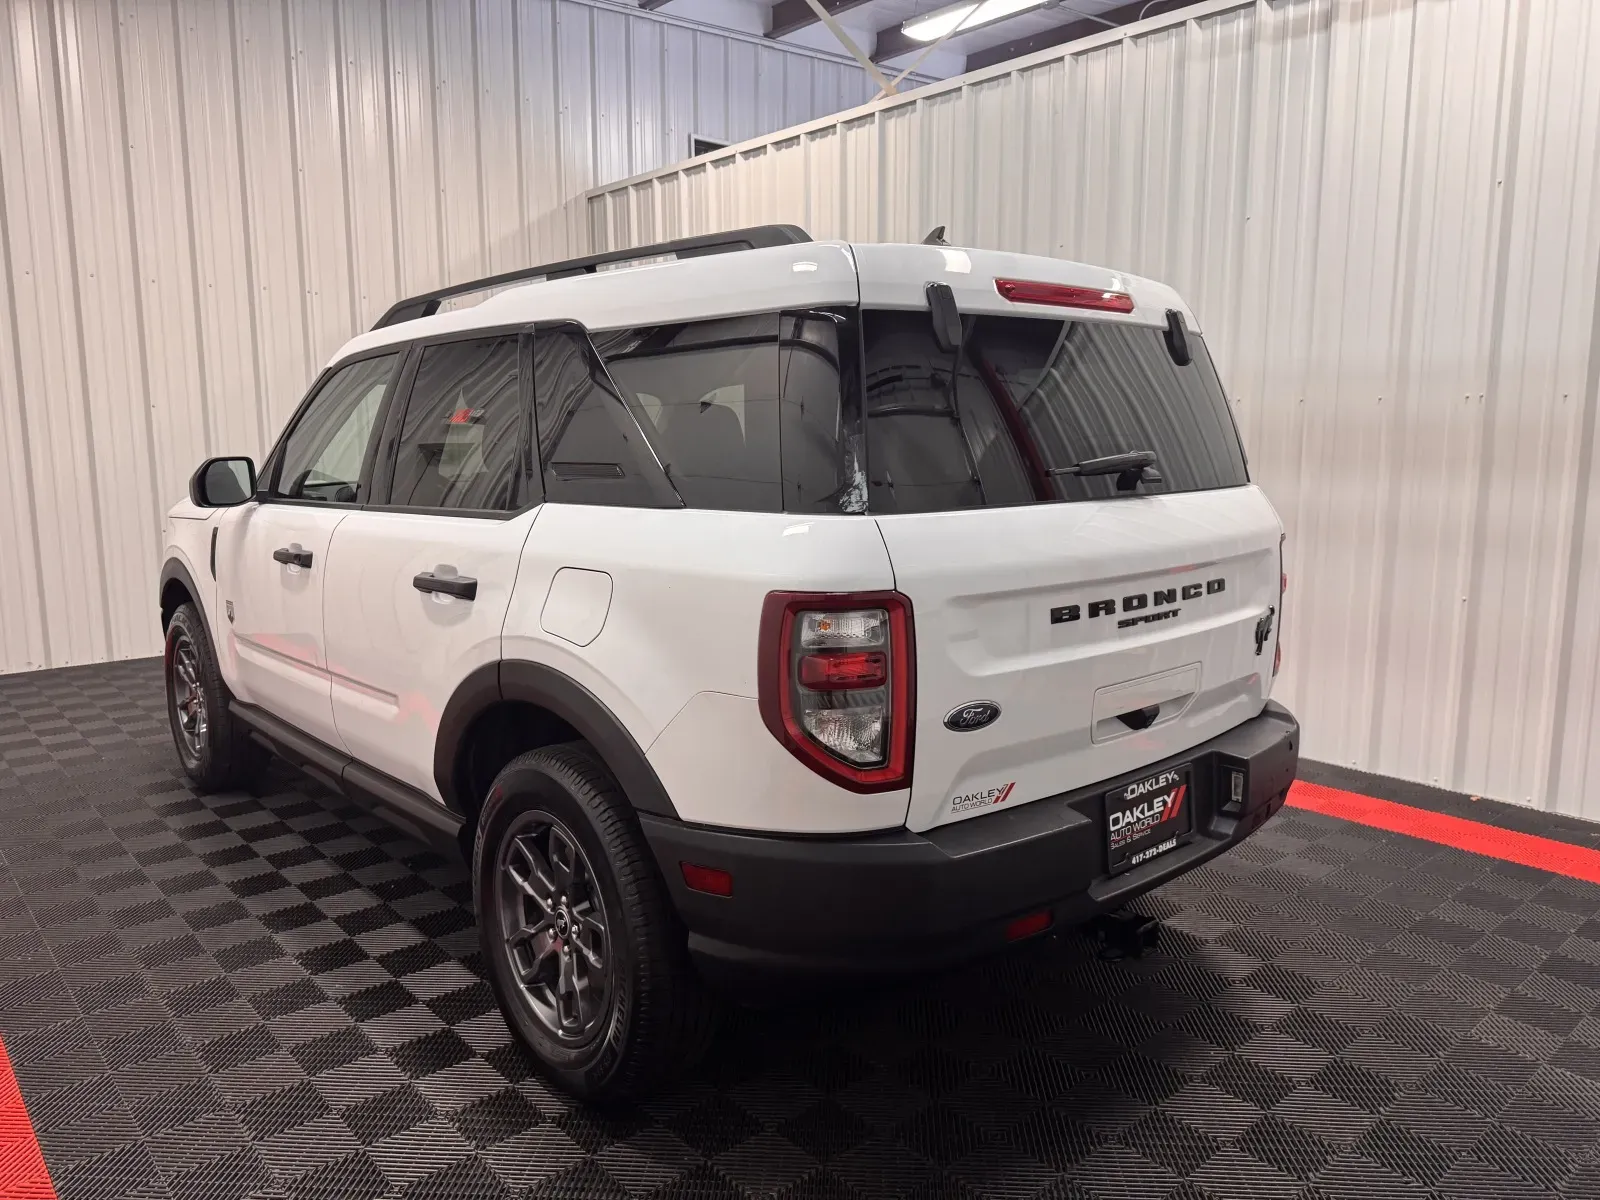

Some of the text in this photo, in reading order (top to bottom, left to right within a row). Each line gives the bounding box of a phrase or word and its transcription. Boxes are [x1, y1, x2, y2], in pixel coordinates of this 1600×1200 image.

[1050, 578, 1226, 625] BRONCO
[1117, 608, 1182, 629] SPORT
[959, 707, 991, 726] Ford
[952, 784, 1009, 805] OAKLEY
[1126, 770, 1175, 800] OAKLEY
[951, 797, 993, 812] AUTO WORLD
[1109, 791, 1176, 831] OAKLEY
[1110, 813, 1161, 841] AUTO WORLD
